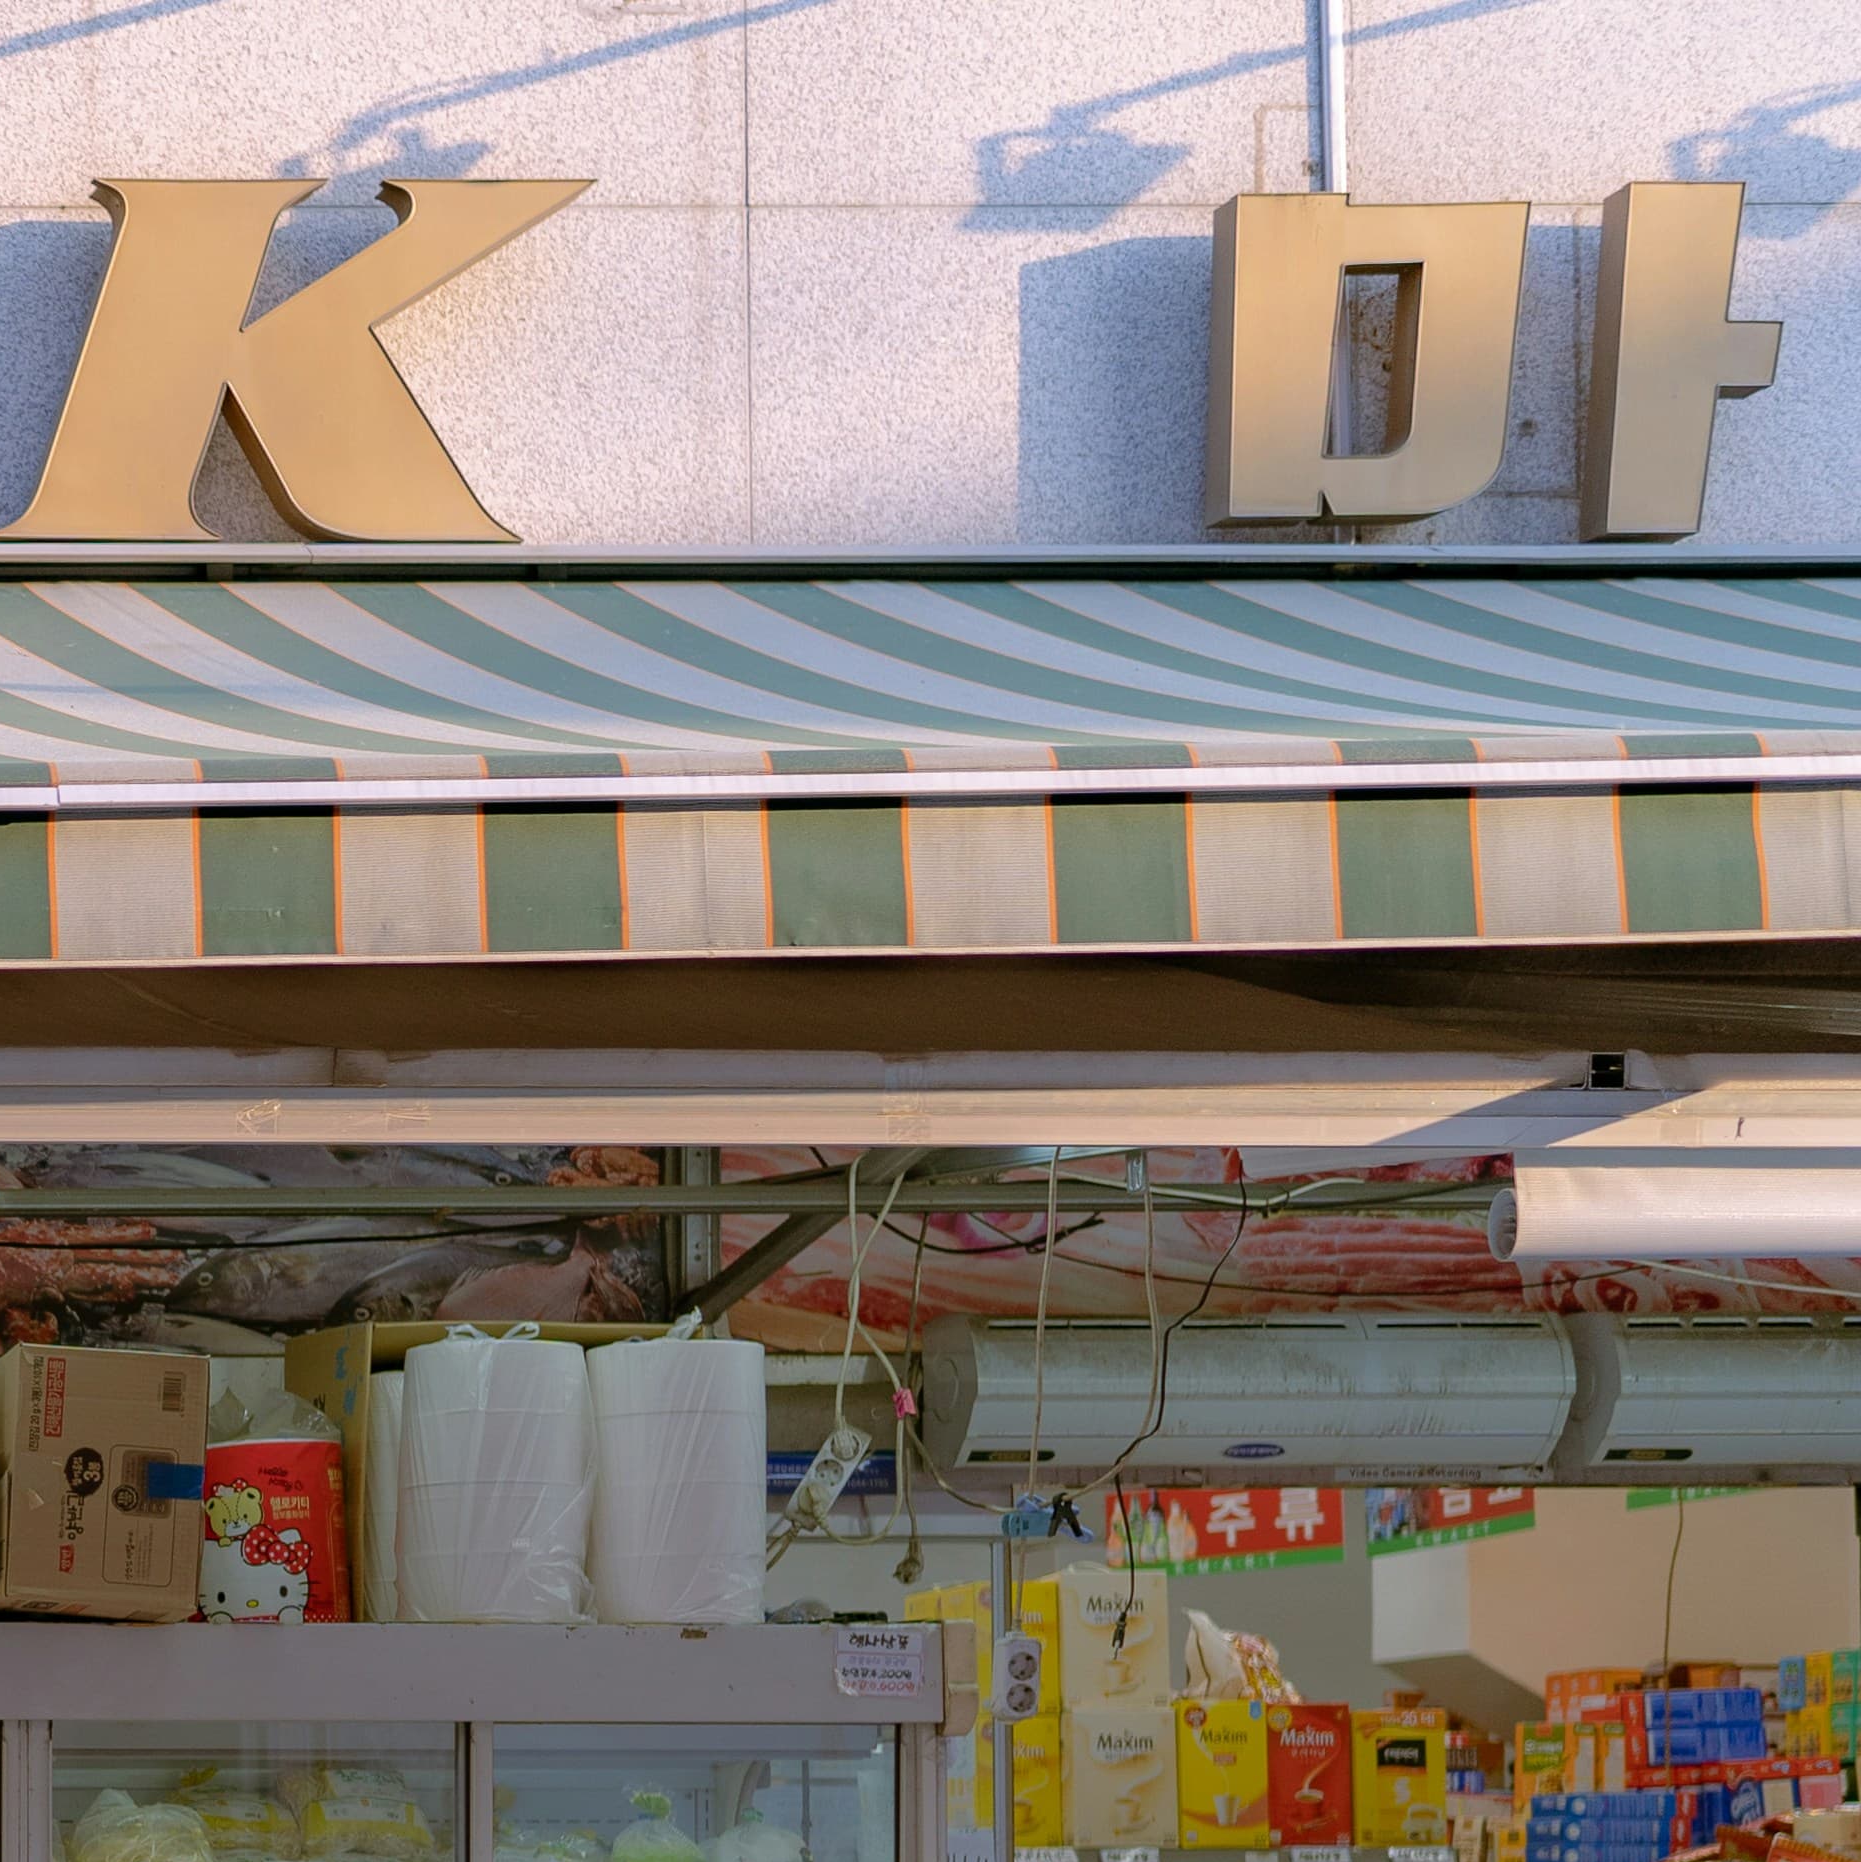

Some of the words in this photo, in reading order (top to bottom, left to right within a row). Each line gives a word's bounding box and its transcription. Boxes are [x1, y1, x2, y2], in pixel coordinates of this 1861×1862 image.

[1205, 1487, 1325, 1549] 주류
[1096, 1729, 1154, 1751] Maxim
[1199, 1725, 1249, 1745] Maxim
[1280, 1725, 1335, 1748] Maxim
